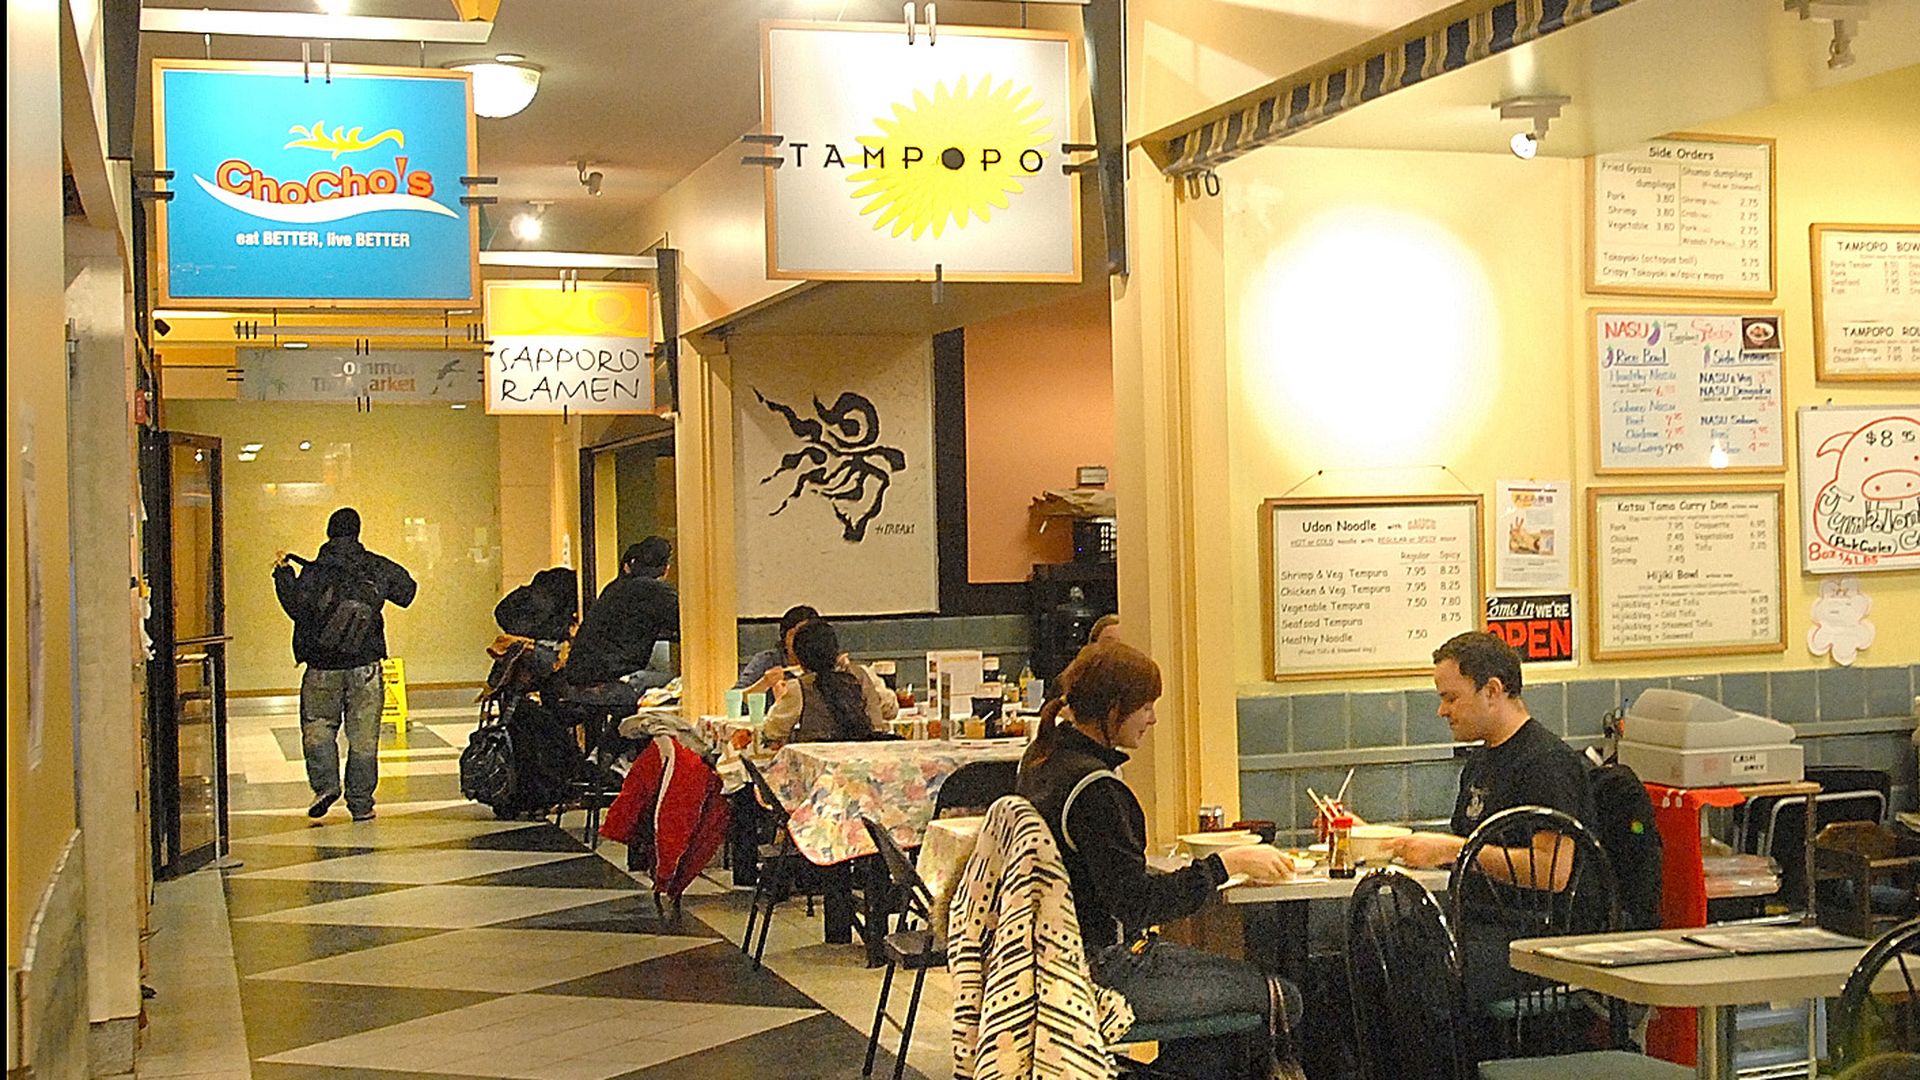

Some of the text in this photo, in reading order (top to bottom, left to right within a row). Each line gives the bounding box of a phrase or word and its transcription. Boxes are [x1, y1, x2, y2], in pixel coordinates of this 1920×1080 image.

[789, 143, 1044, 172] TAMPOPO
[1648, 147, 1714, 161] Side Orders
[1602, 162, 1625, 173] Fried
[215, 155, 435, 204] ChoCho's
[1606, 190, 1626, 201] Pork
[1608, 205, 1638, 217] Shrimp
[1608, 220, 1649, 232] Vegetable
[236, 231, 410, 249] eat BETTER, live BETTER
[1837, 241, 1888, 252] TAMPOPO
[1605, 321, 1649, 339] NASU
[1842, 327, 1894, 337] TAMPOPO
[500, 346, 641, 373] SAPPORO
[1700, 372, 1730, 384] NASU
[500, 377, 641, 402] RAMEN
[1700, 386, 1729, 397] NASU
[1618, 502, 1645, 512] Katsu
[1650, 501, 1676, 512] Tama
[1679, 501, 1706, 513] Curry
[1302, 521, 1332, 533] Udon
[1336, 520, 1377, 532] Noodle
[1401, 550, 1461, 561] Regular Spicy
[1281, 565, 1461, 582] Shrimp & Veg Tempura 7.95 8.25
[1677, 569, 1699, 580] Bowl
[1280, 581, 1461, 597] Chicken & Veg Tempura 7.95 8.25
[1281, 602, 1327, 615] Vegetable
[1331, 601, 1370, 612] Tempura
[1407, 597, 1428, 608] 7.50
[1520, 600, 1535, 616] In
[1536, 602, 1569, 618] WE'RE
[1281, 612, 1462, 629] Seafood Tempura 8.75
[1281, 629, 1428, 646] Healthy Noodle 7.50
